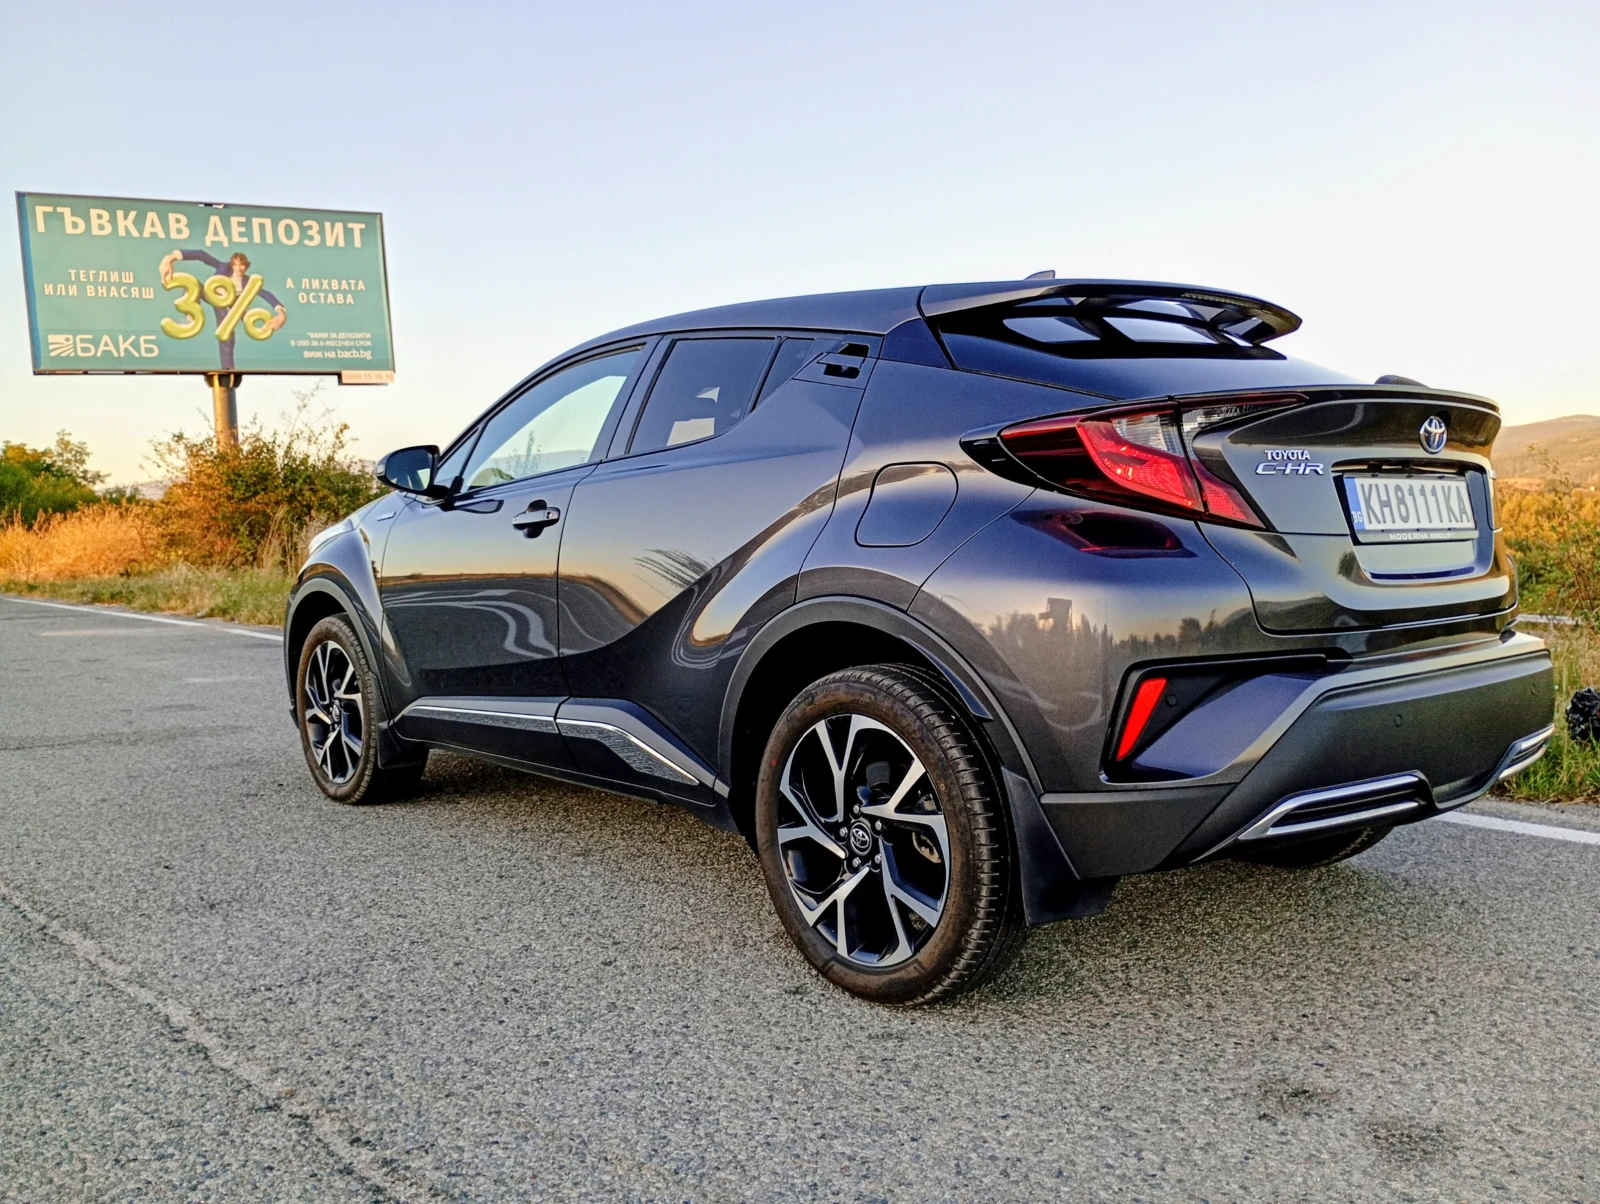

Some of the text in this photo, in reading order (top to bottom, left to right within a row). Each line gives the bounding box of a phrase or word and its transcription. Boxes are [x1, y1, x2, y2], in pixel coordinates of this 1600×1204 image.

[35, 205, 366, 248] ГЪВКАВ ДЕПОЗИТ
[68, 269, 134, 283] ТЕГЛИШ
[286, 278, 365, 291] А ЛИХВАТА
[44, 284, 154, 299] ИЛИ ВНАСЯШ
[298, 293, 354, 304] ОСТАВА
[160, 272, 276, 341] 3%
[76, 334, 159, 358] БАКБ
[337, 348, 372, 360] bacb.bg
[1264, 449, 1311, 461] TOYOTA
[1255, 462, 1324, 475] C-HR
[1351, 511, 1363, 523] BG
[1389, 532, 1429, 541] MODERNA
